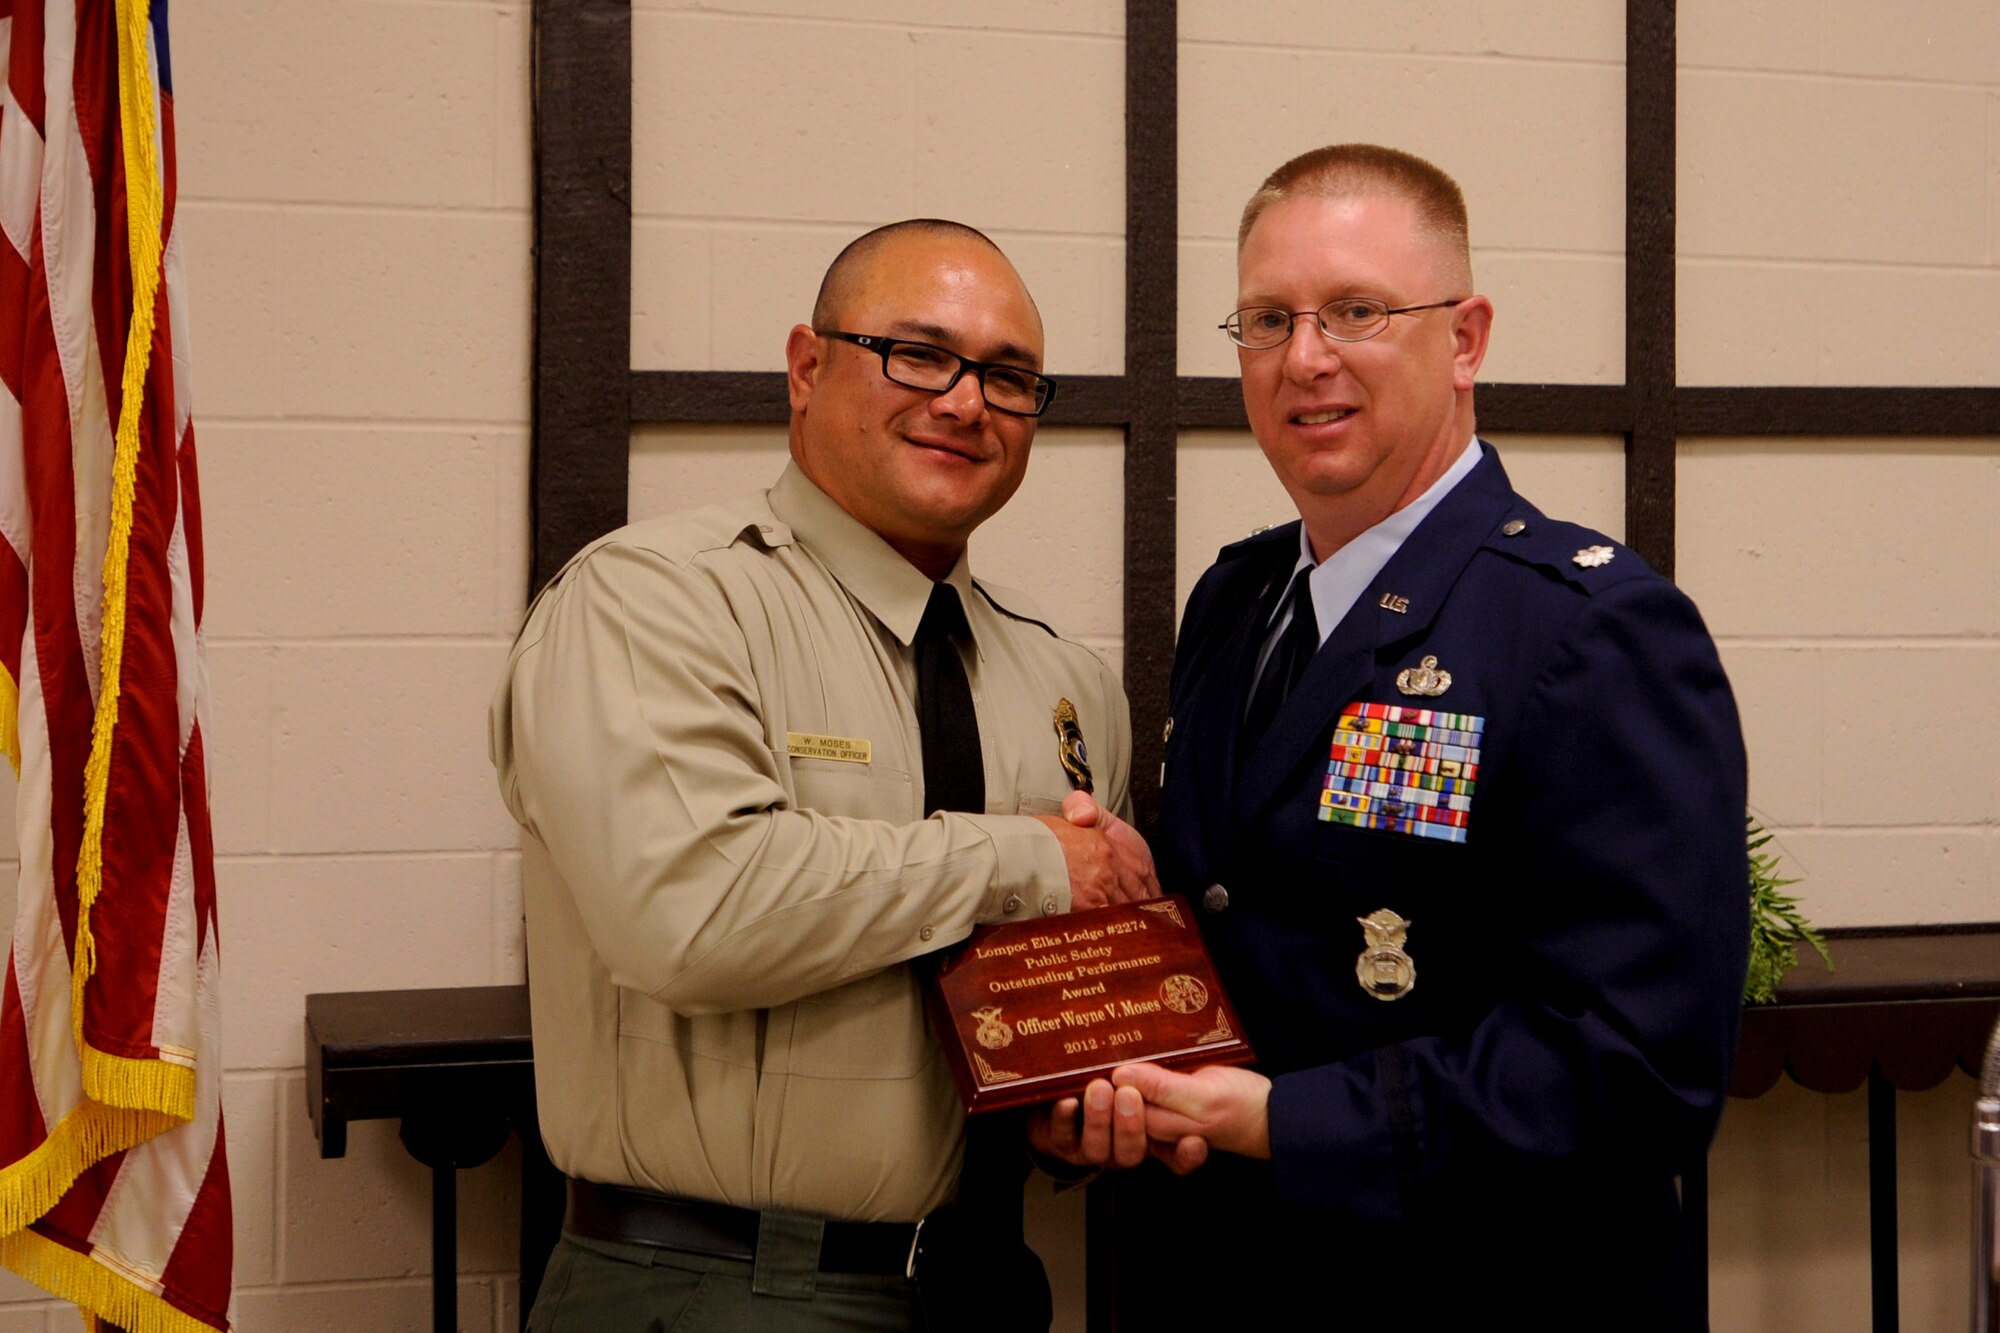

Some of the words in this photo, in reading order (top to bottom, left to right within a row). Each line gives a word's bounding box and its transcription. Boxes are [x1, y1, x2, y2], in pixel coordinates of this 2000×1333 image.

[787, 745, 836, 756] CONSERVATION
[840, 750, 867, 760] OFFICER
[820, 739, 851, 749] MOSES
[976, 941, 1028, 960] Lompoc
[1031, 933, 1061, 950] Elks
[1064, 927, 1105, 945] Lodge
[1106, 920, 1148, 936] #2274
[1025, 953, 1068, 970] Public
[1070, 944, 1113, 961] Safety
[988, 969, 1075, 993] Outstanding
[1077, 954, 1161, 978] Performance
[1061, 983, 1106, 1001] Award
[1016, 1017, 1061, 1037] Officer
[1061, 1008, 1106, 1029] Wayne
[1105, 1003, 1121, 1020] V.
[1120, 999, 1161, 1018] Moses
[1064, 1039, 1098, 1054] 2012
[1109, 1030, 1143, 1046] 2013
